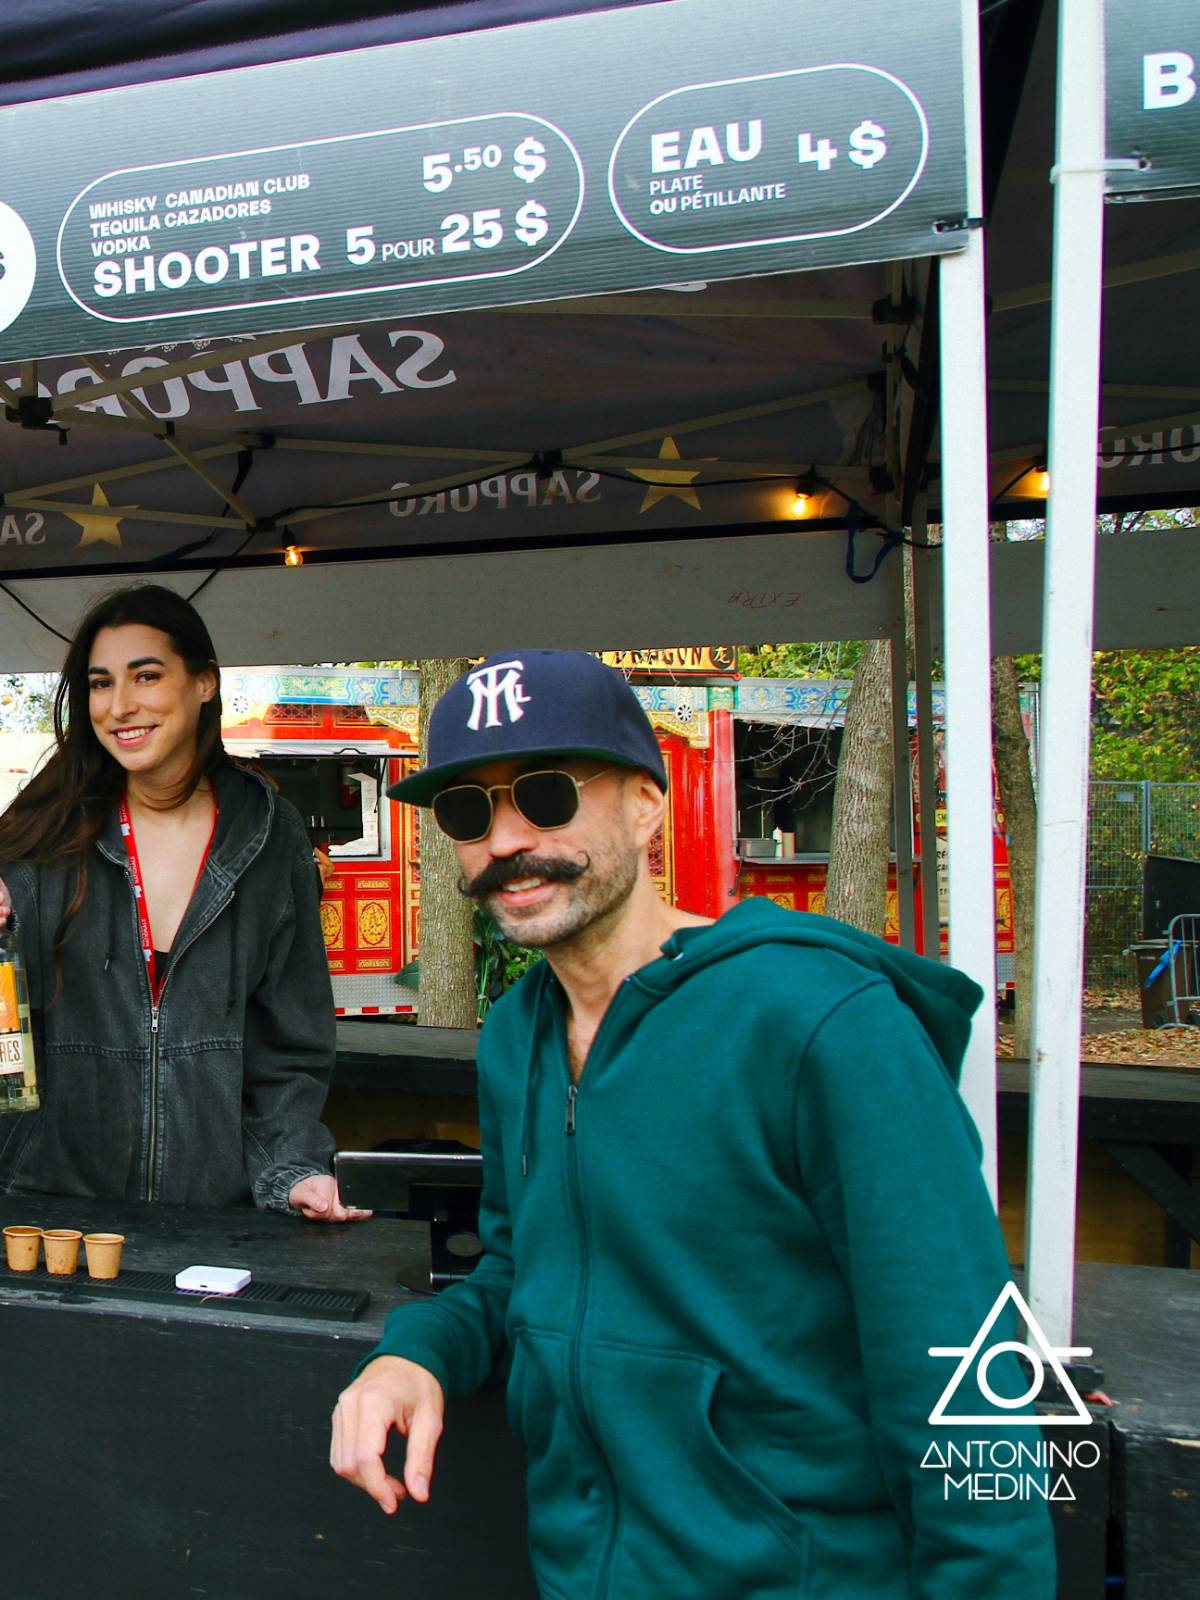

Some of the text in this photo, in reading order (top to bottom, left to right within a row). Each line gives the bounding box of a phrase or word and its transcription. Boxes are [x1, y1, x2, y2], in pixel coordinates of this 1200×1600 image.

[651, 119, 762, 174] EAU
[798, 133, 837, 171] 4
[89, 196, 157, 219] WHISKY
[165, 180, 259, 208] CANADIAN
[263, 174, 310, 194] CLUB
[650, 174, 703, 196] PLATE
[650, 182, 786, 215] OU PÉTILLANTE
[90, 199, 272, 239] TEQUILA CAZADORES
[91, 235, 151, 257] VODKA
[93, 233, 321, 298] SHOOTER
[346, 225, 376, 265] 5
[382, 237, 435, 261] POUR
[439, 208, 504, 254] 25
